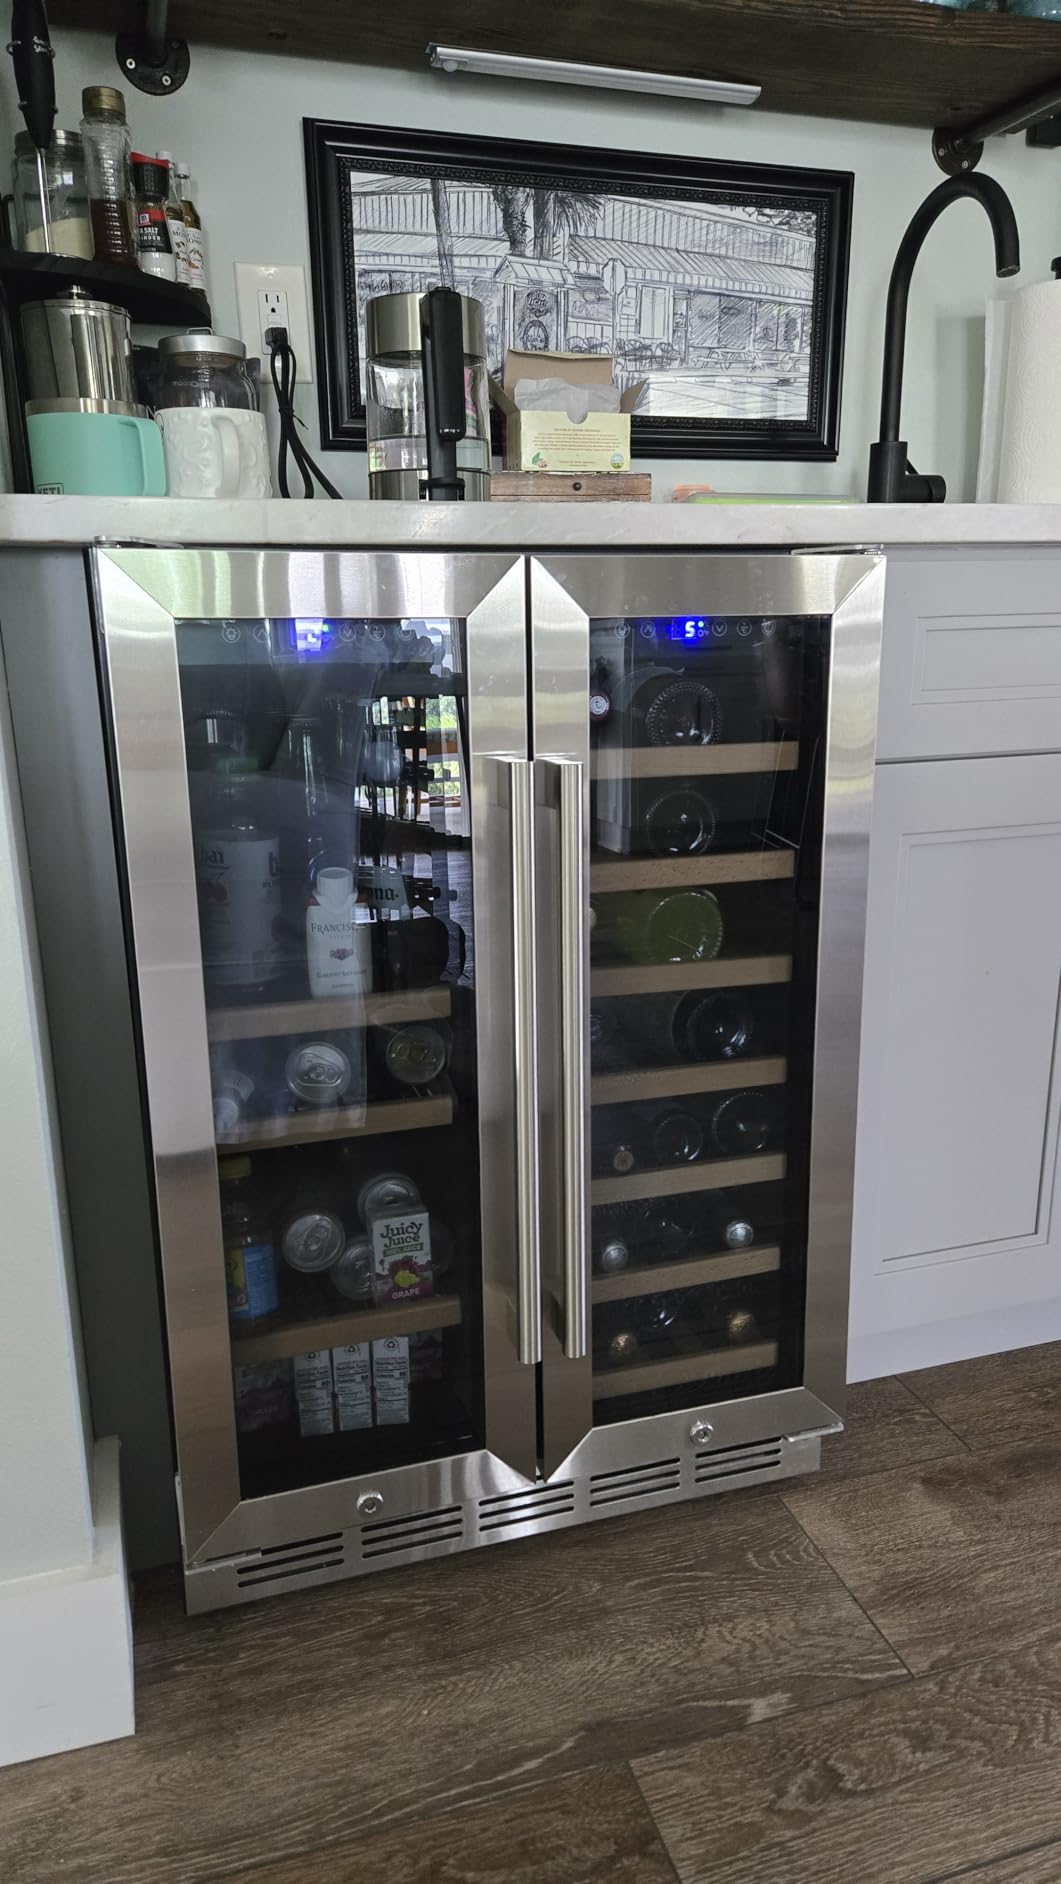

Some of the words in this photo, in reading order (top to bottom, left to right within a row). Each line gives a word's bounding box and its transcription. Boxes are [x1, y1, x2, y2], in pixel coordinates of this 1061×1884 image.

[381, 1221, 424, 1238] Juicy
[384, 1235, 420, 1248] Juice
[392, 1288, 421, 1300] GRAPE
